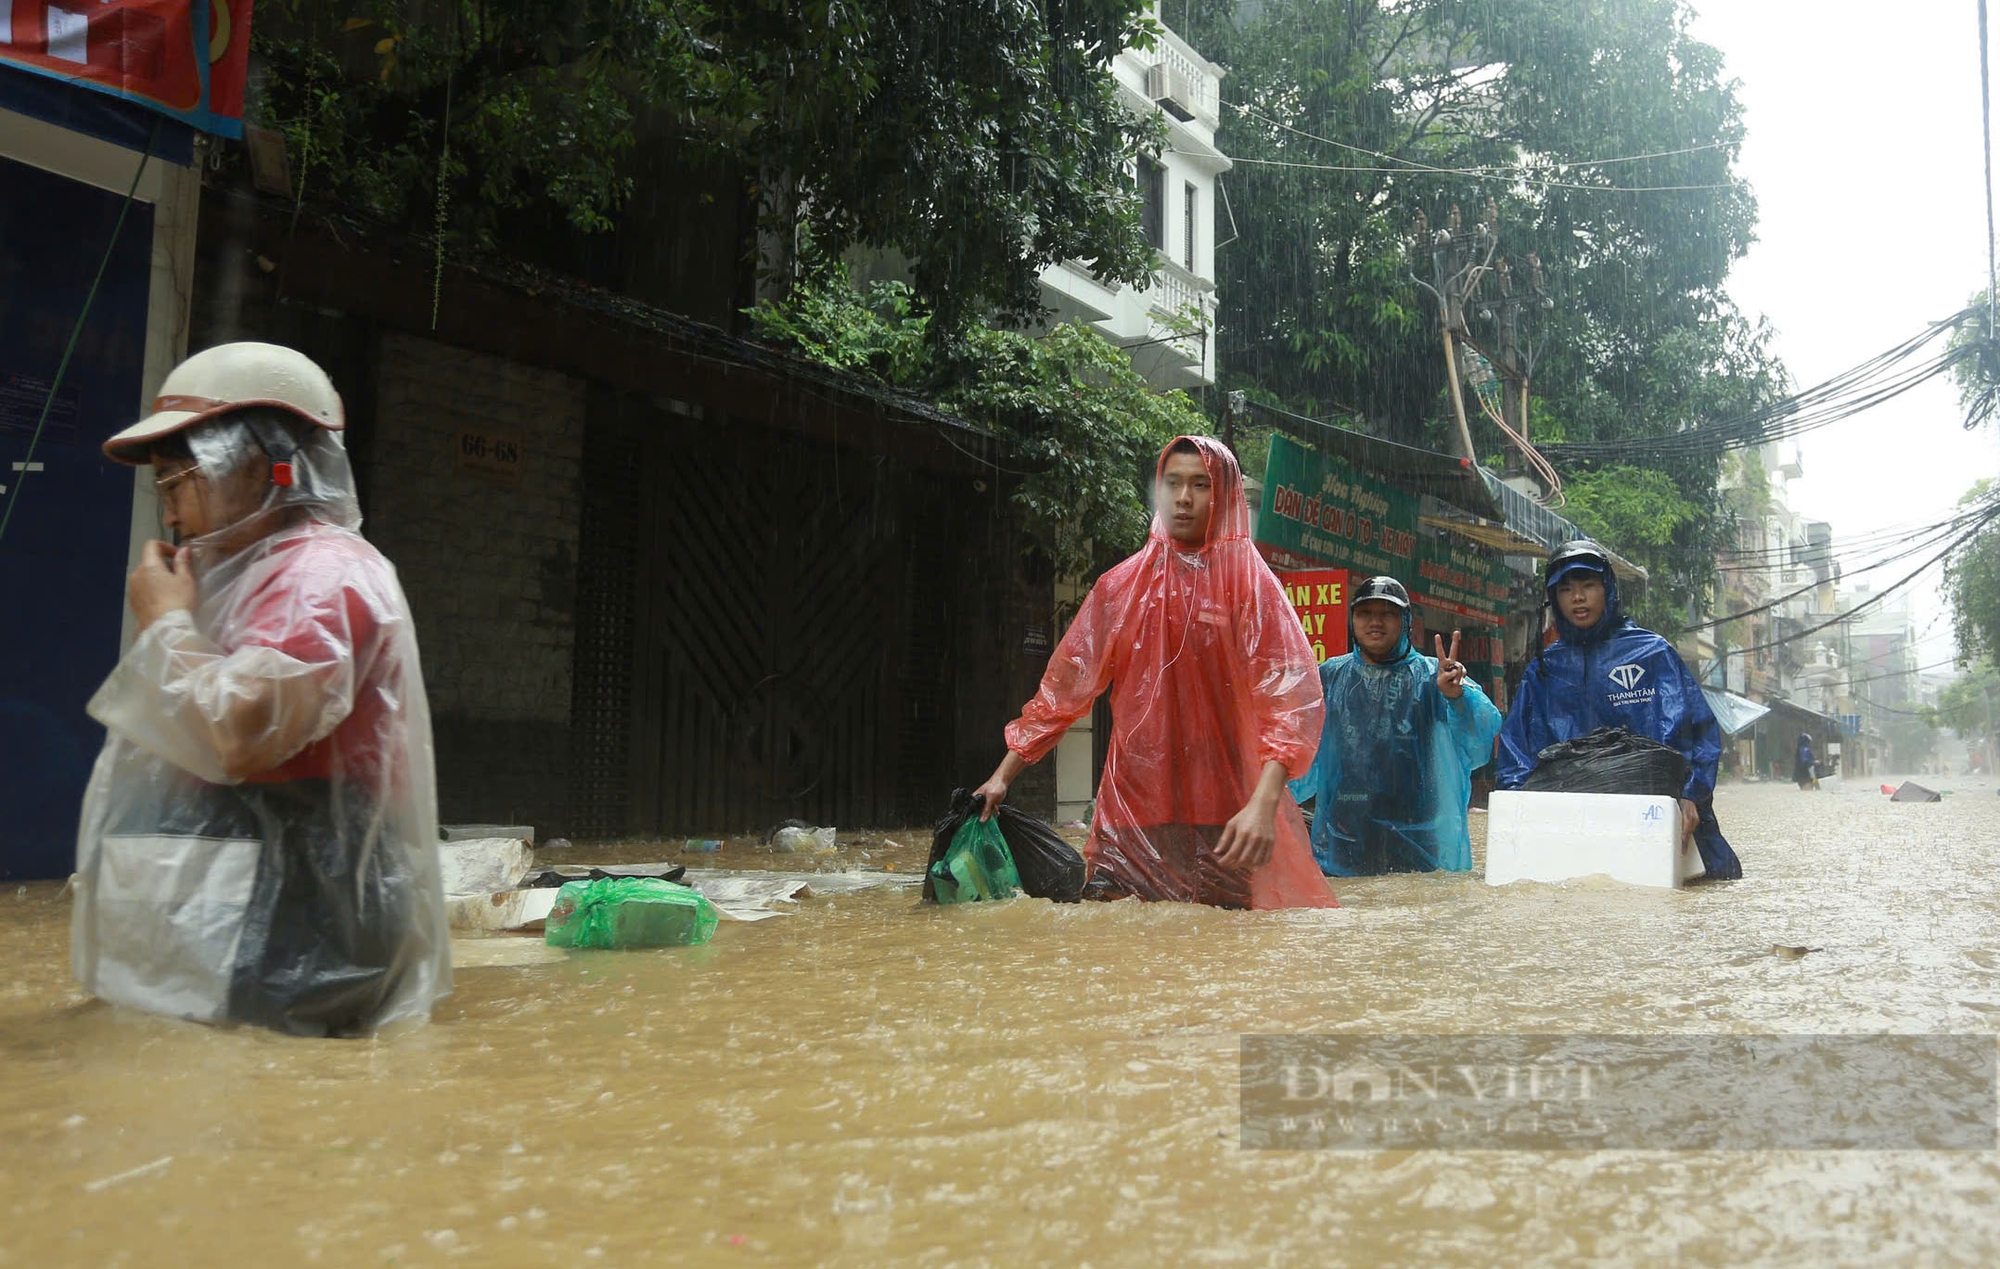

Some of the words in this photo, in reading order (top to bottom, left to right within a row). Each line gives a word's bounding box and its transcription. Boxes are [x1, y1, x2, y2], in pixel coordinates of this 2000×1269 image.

[1273, 483, 1303, 521] DÁN
[1322, 504, 1345, 536] CAN
[1379, 525, 1395, 553] XE
[1285, 582, 1310, 606] ÁN
[1316, 583, 1342, 605] XE
[1304, 610, 1326, 635] ÁY
[1312, 639, 1326, 665] Ô
